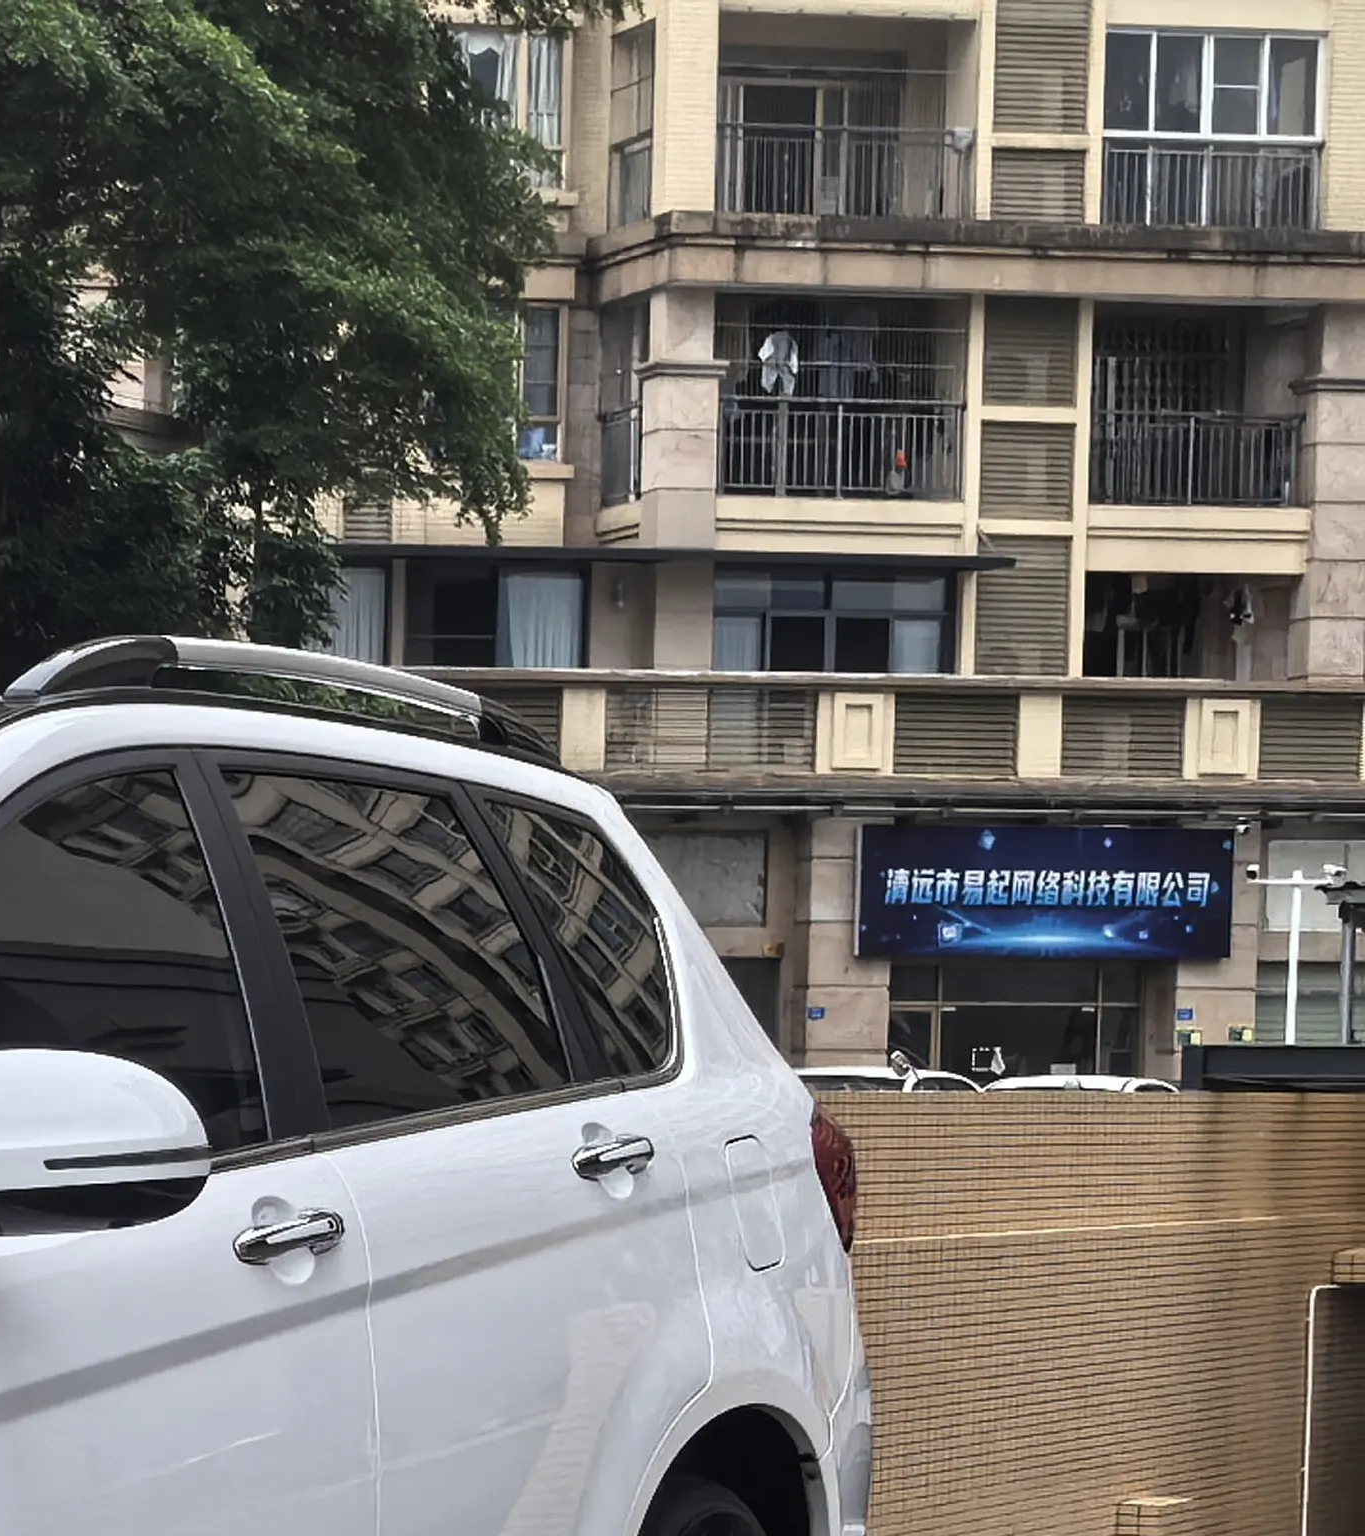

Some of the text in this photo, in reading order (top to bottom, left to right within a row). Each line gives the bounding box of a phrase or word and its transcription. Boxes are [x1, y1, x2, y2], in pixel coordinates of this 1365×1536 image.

[884, 868, 1211, 907] 清远市易起网络科技有限公司
